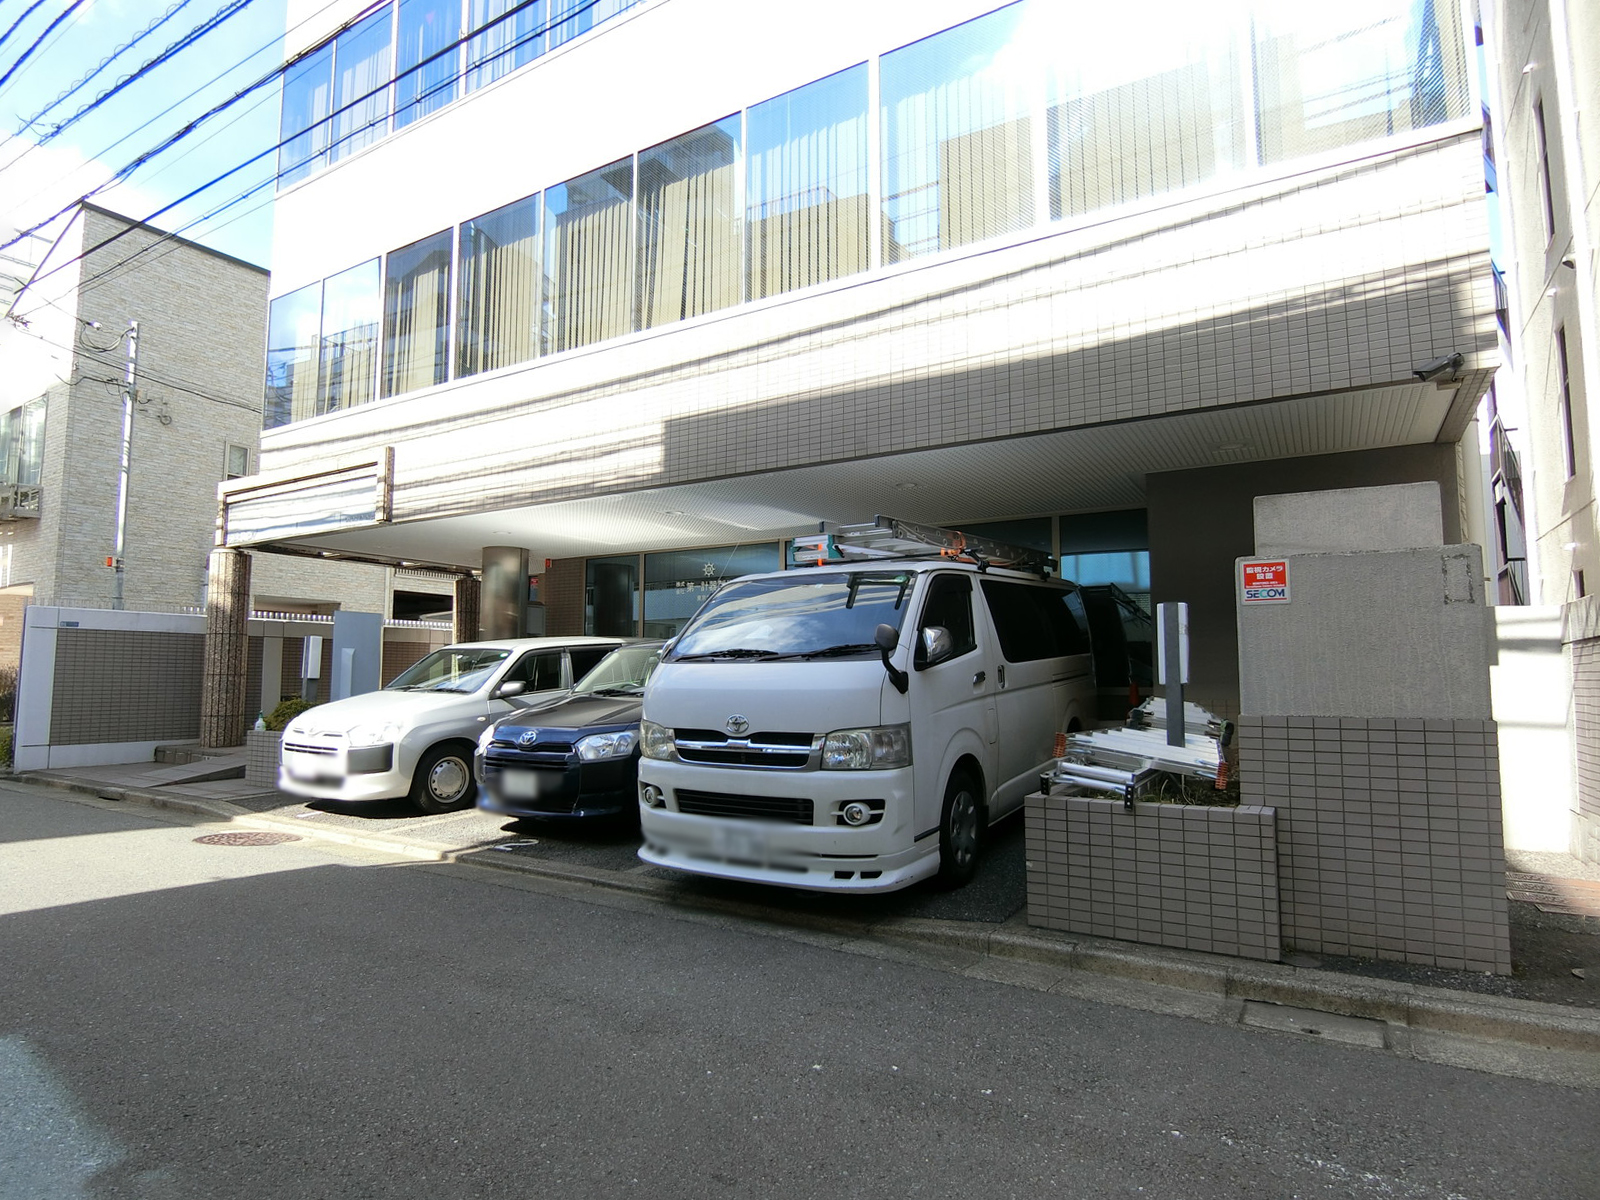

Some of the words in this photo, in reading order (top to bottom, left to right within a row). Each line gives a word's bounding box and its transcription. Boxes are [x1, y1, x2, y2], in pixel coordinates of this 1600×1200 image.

[1246, 565, 1283, 574] 監視カメラ
[1246, 588, 1285, 599] SECOM
